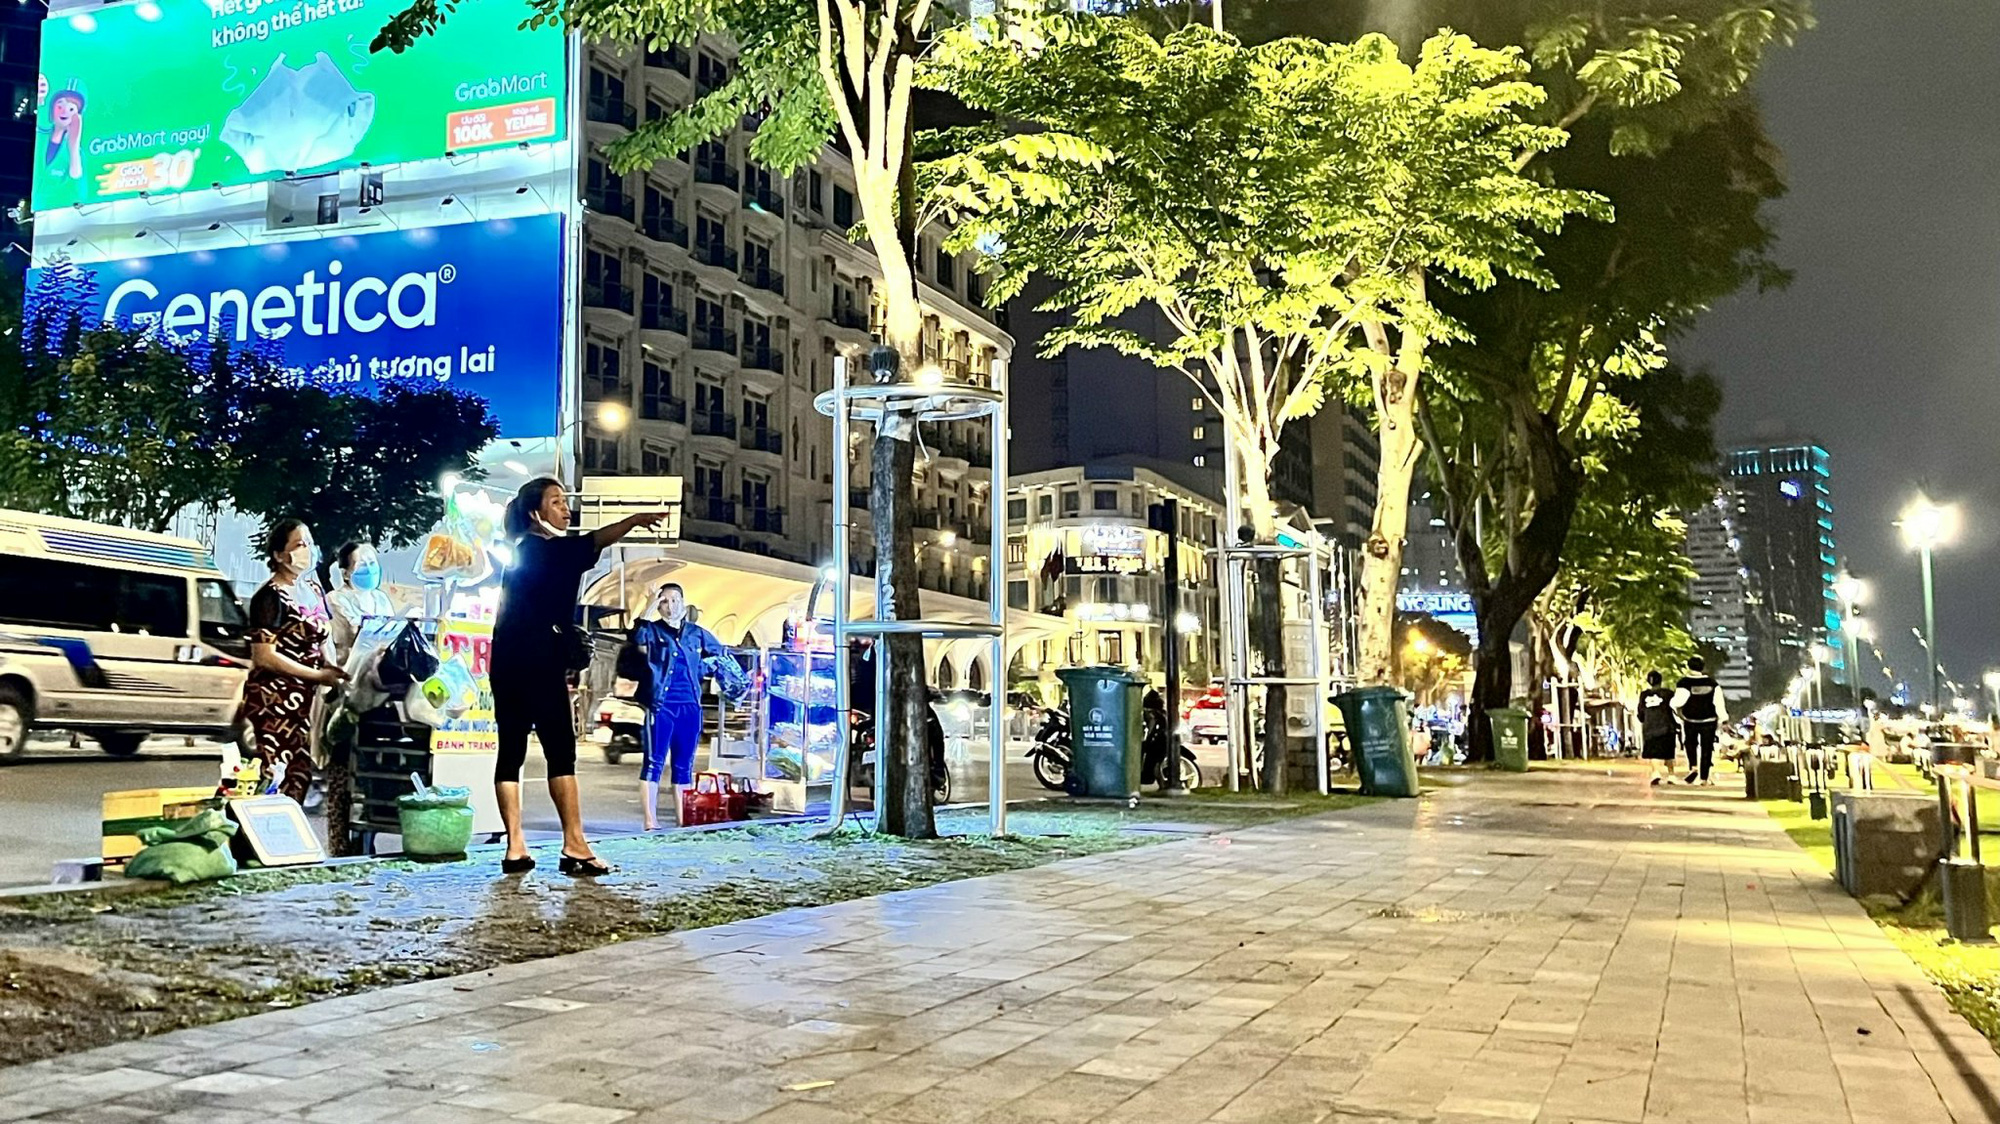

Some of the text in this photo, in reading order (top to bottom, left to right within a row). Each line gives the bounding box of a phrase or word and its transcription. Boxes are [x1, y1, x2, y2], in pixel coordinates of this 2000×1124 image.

[211, 20, 269, 48] không
[455, 72, 548, 102] GrabMart
[453, 121, 494, 144] 100K
[504, 112, 548, 132] YEUME
[89, 124, 211, 155] GrabMart ngay!
[369, 355, 451, 382] tương
[461, 345, 495, 374] lai
